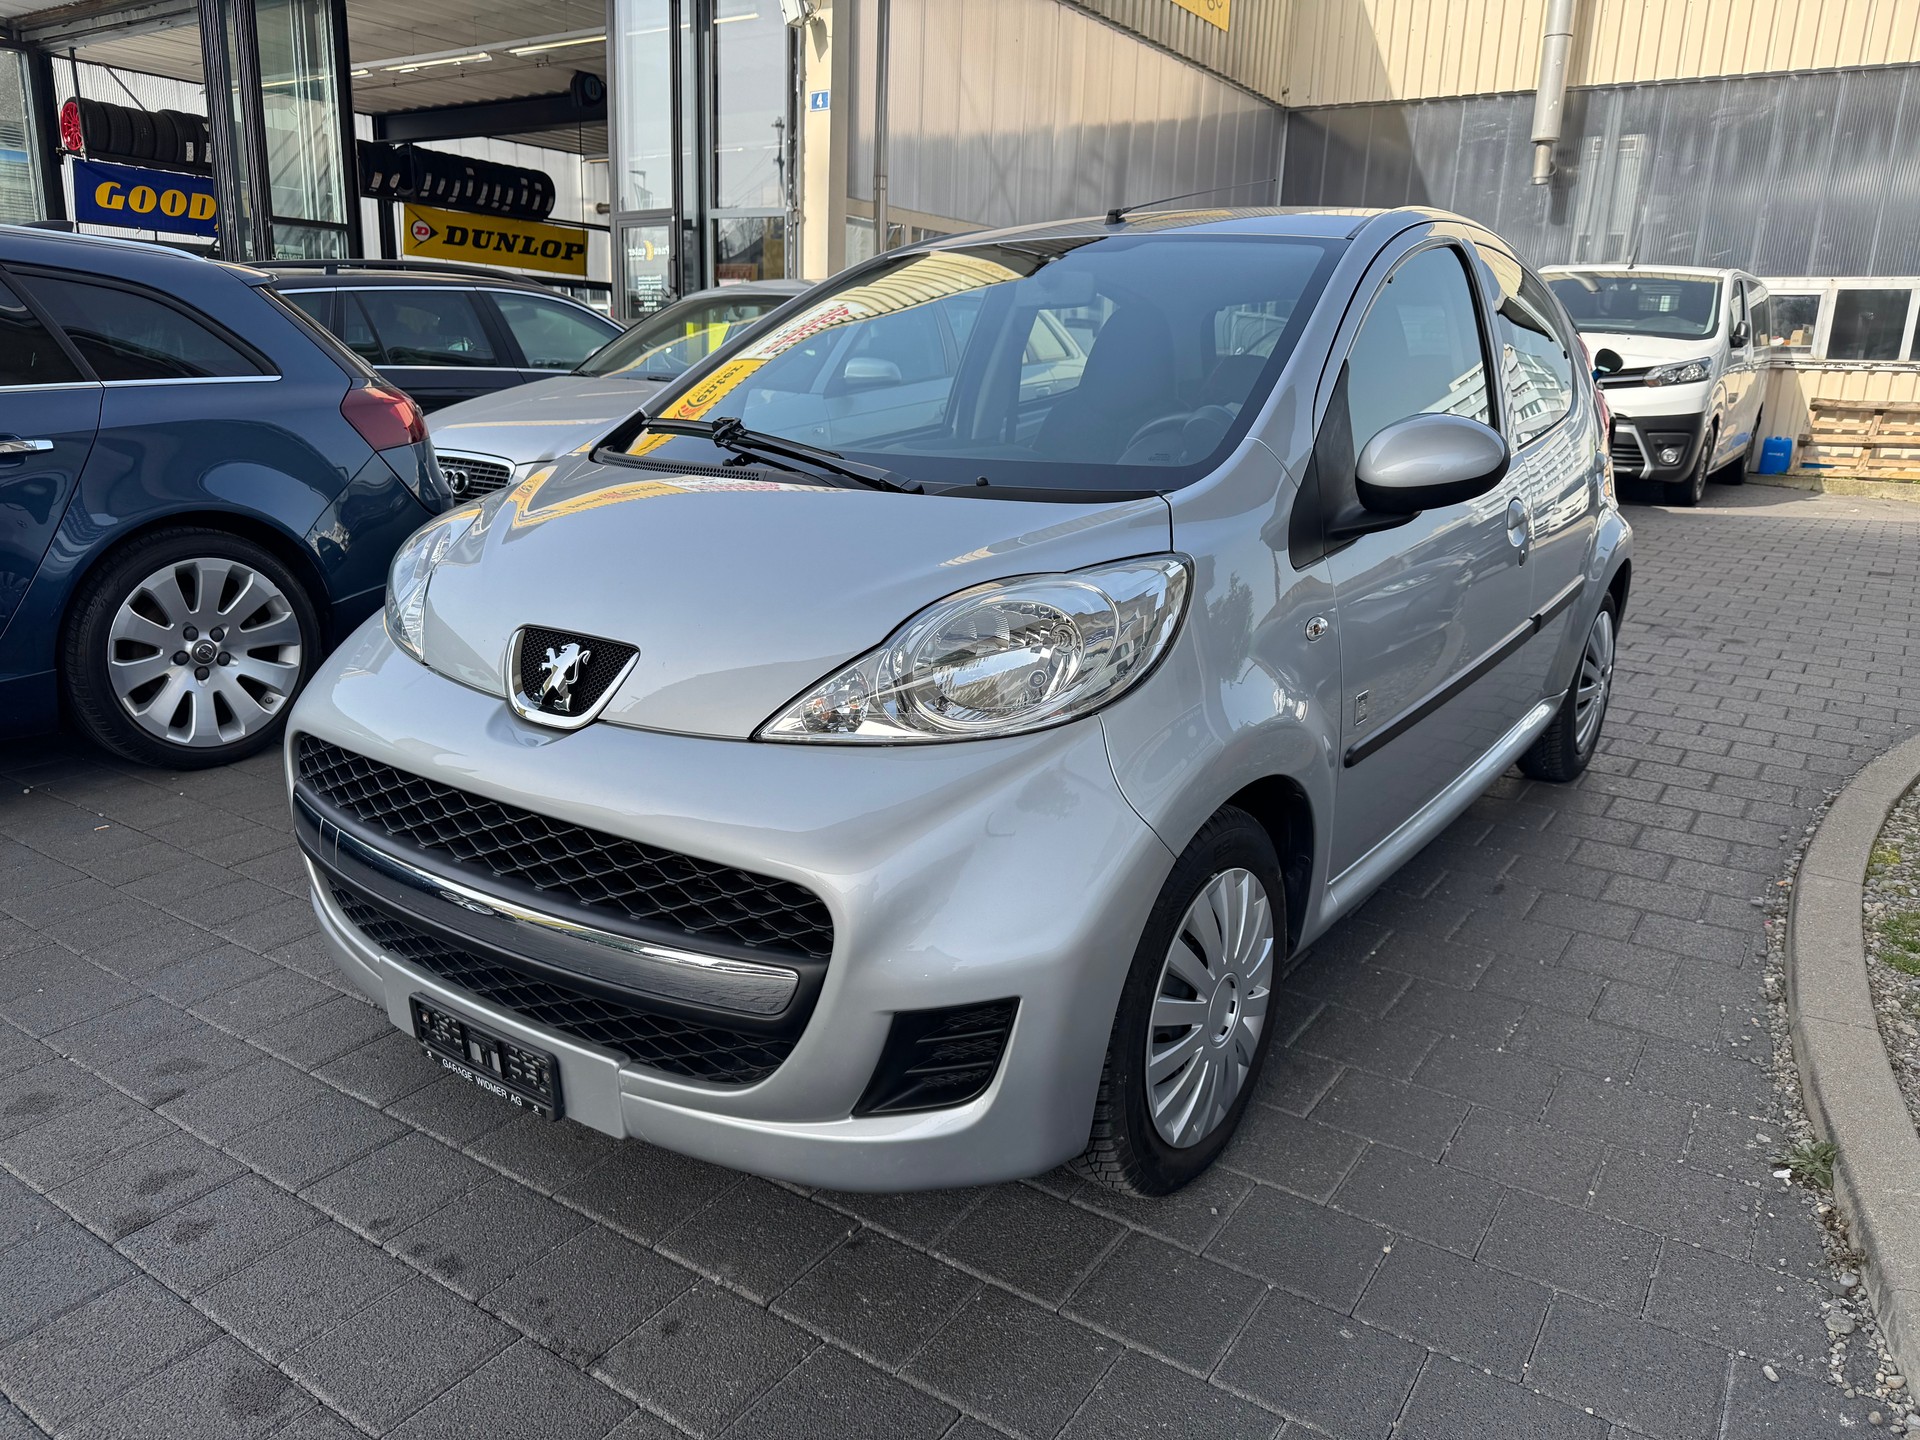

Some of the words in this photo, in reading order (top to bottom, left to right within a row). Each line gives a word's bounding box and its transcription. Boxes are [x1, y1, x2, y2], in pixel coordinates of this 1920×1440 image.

[816, 93, 823, 108] 4
[442, 225, 585, 261] DUNLOP
[442, 1058, 473, 1082] GARAGE
[475, 1075, 508, 1099] WIDMER
[510, 1094, 523, 1107] AG
